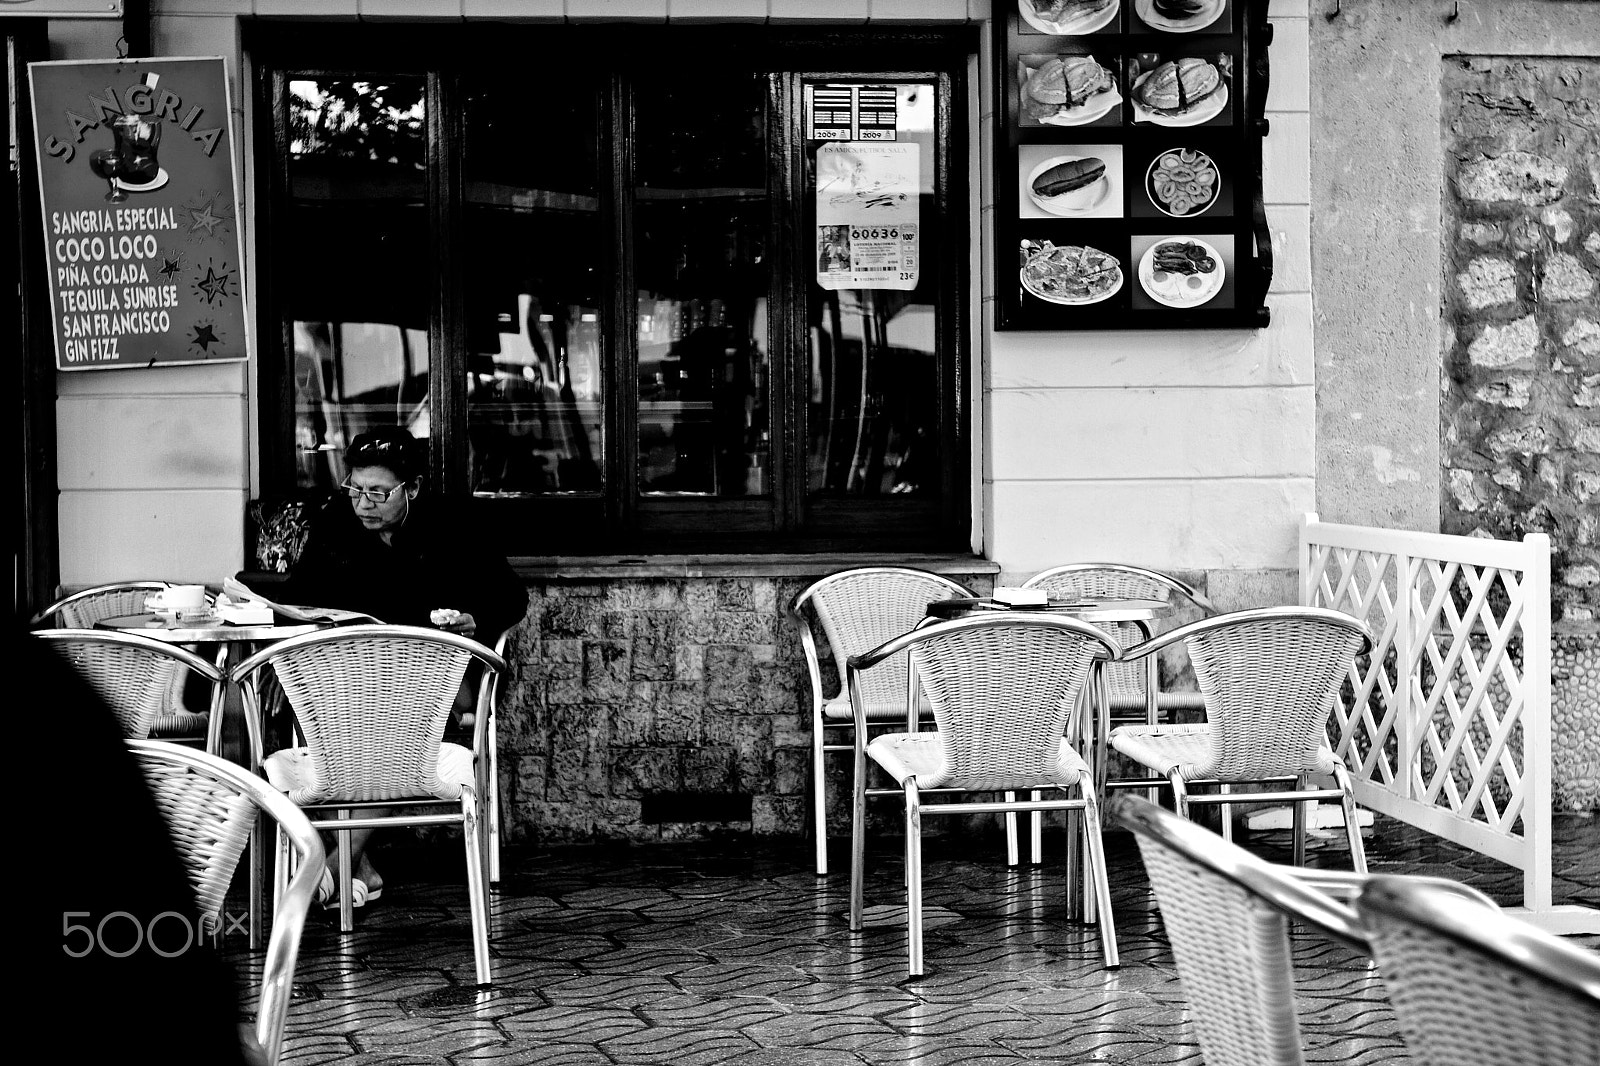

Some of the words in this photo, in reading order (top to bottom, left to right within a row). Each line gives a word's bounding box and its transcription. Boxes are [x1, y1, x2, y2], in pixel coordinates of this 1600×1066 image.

[44, 83, 224, 164] SANGRIA
[52, 209, 114, 234] SANGRIA
[116, 207, 178, 231] ESPECIAL
[852, 228, 898, 239] 60636
[56, 236, 105, 263] COCO
[109, 234, 158, 260] LOCO
[58, 264, 90, 287] PIÑA
[93, 263, 149, 286] COLADA
[900, 272, 914, 280] 23€
[60, 288, 120, 313] TEQUILA
[123, 285, 178, 310] SUNRISE
[62, 314, 92, 338] SAN
[94, 310, 170, 336] FRANCISCO
[65, 339, 88, 362] GIN
[90, 338, 120, 361] FIZZ
